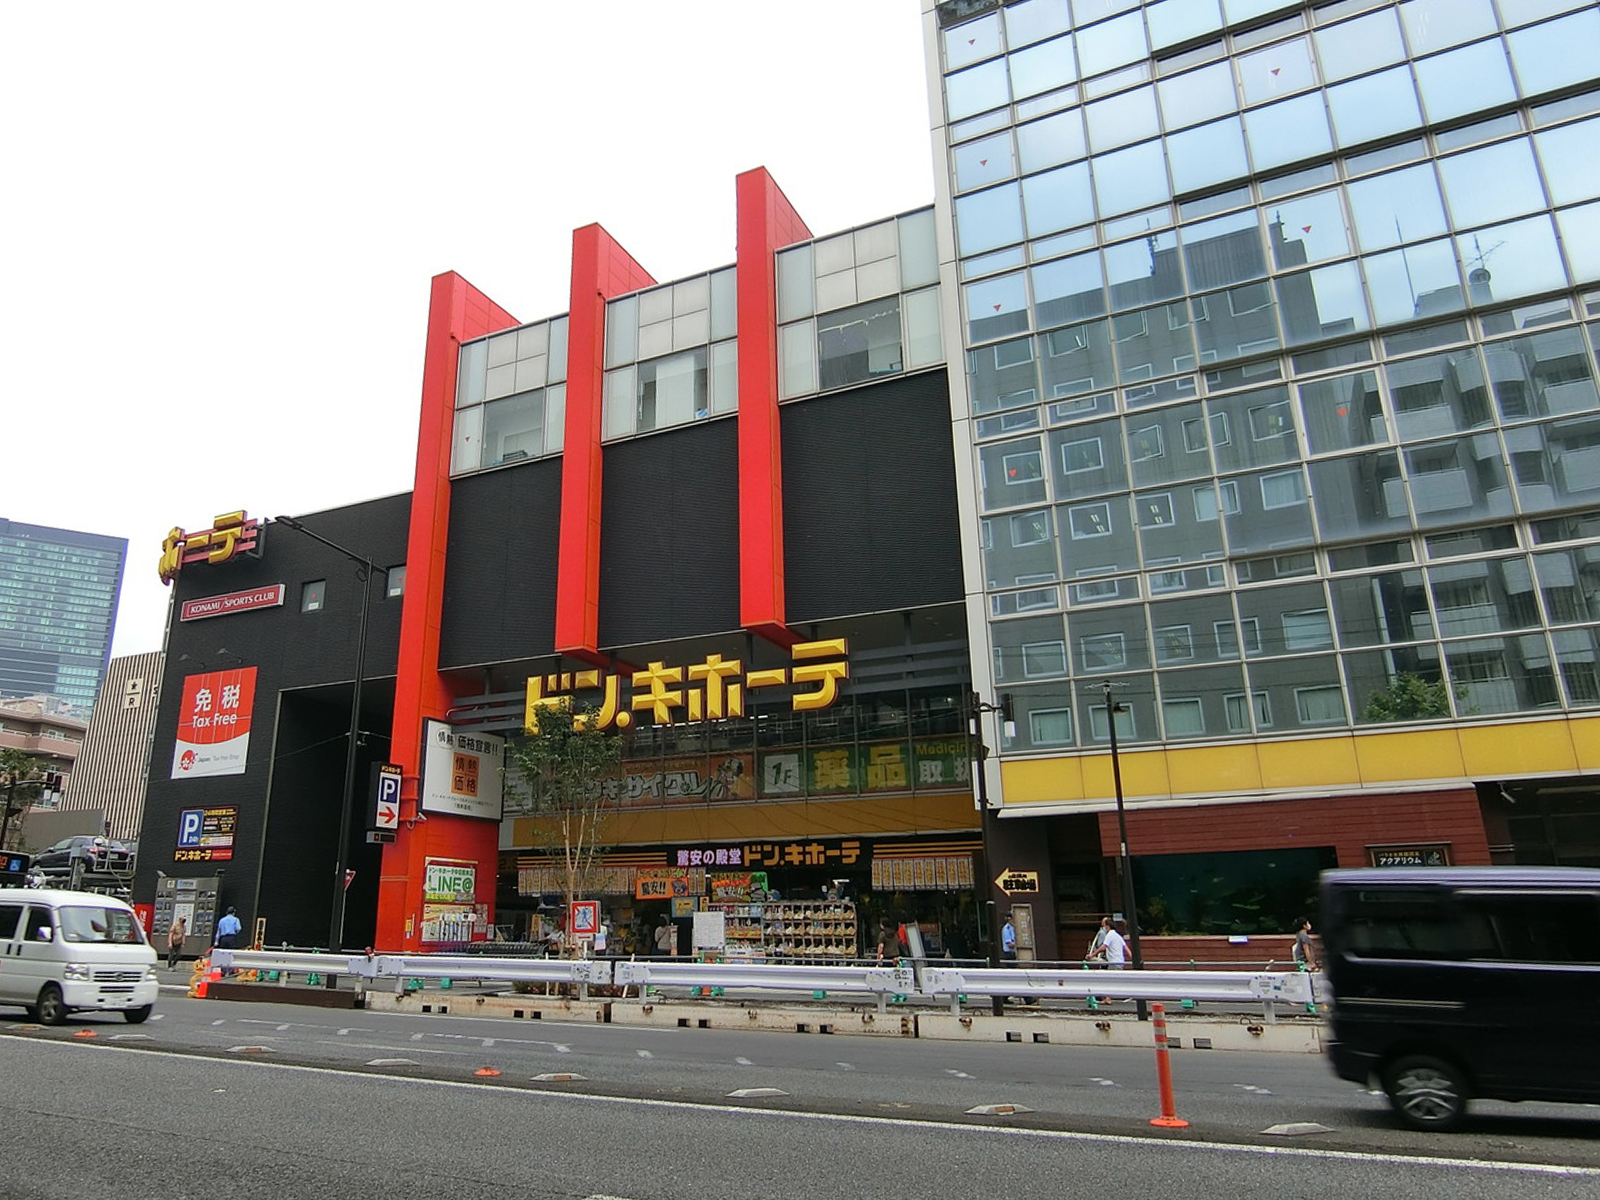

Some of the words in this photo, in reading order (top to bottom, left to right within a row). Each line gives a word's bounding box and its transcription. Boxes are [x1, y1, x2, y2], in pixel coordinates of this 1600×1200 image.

[190, 601, 221, 614] KONAMI
[223, 595, 253, 608] SPORTS
[254, 591, 275, 603] CLUB
[193, 684, 241, 713] 免税
[192, 715, 211, 728] Tax
[213, 712, 238, 726] Free
[773, 761, 793, 786] 1F
[813, 744, 907, 790] 薬品
[383, 779, 395, 800] P
[183, 814, 200, 843] P
[677, 848, 742, 866] 驚安の殿堂
[1379, 856, 1422, 866] アクアリウム
[427, 874, 473, 893] LINE@
